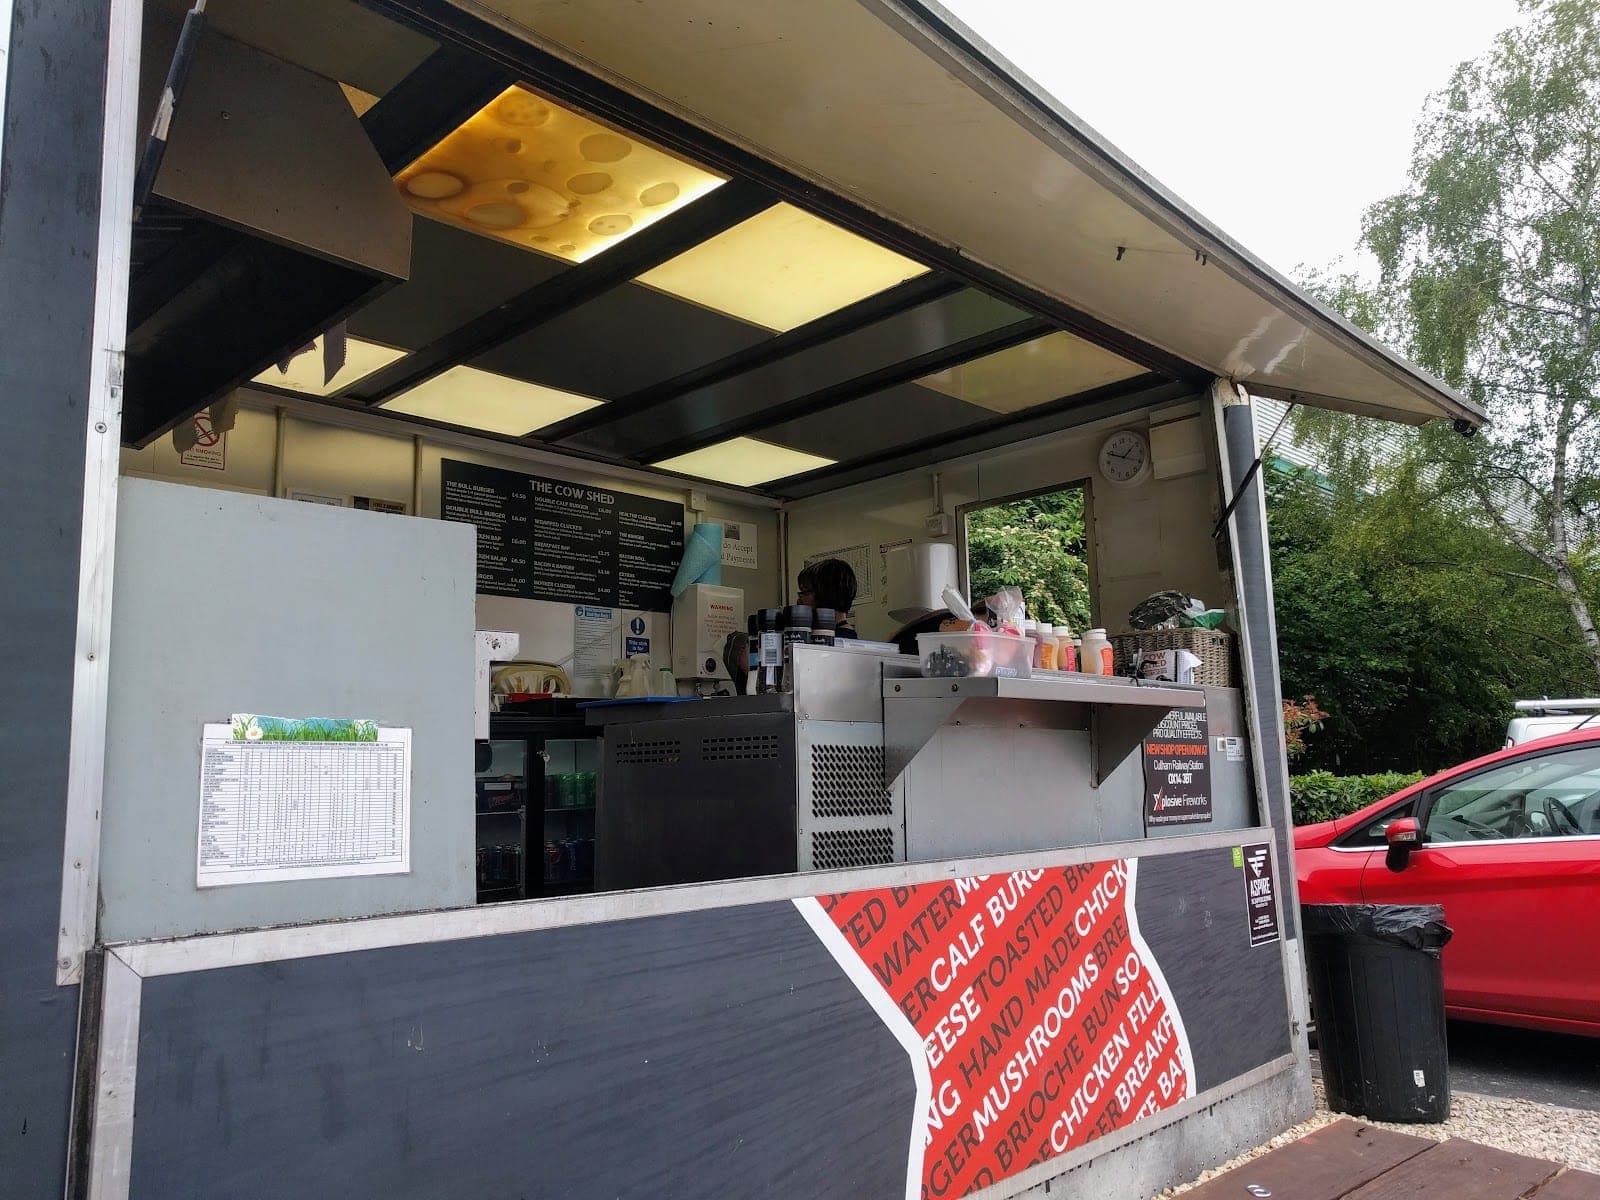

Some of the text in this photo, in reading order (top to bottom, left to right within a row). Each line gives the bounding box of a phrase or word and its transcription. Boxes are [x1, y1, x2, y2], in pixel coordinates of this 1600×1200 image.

[446, 480, 495, 494] THE BULL BURGER
[529, 480, 615, 505] THE COW SHED
[445, 504, 506, 520] DOUBLE BULL BURGER
[534, 496, 556, 506] DOUBLE
[556, 499, 569, 507] CALF
[569, 501, 589, 511] BURGER
[726, 552, 756, 565] Payments
[1181, 720, 1198, 730] PRICES
[1184, 712, 1207, 722] AVAILABLE
[1152, 728, 1163, 738] PRO
[1146, 743, 1160, 755] NEW
[1160, 743, 1175, 755] SHOP
[1175, 743, 1188, 755] OPEN
[1250, 876, 1271, 897] ASPIRE
[840, 898, 886, 949] ED
[930, 912, 984, 992] CALF
[972, 885, 1063, 1002] TOASTED
[959, 996, 1023, 1089] HAND
[1025, 921, 1080, 1006] MADE
[973, 953, 1099, 1143] MUSHROOMS
[994, 1034, 1085, 1171] BRIOCHE
[1081, 980, 1121, 1044] BUN
[1051, 1022, 1130, 1152] CHICKEN
